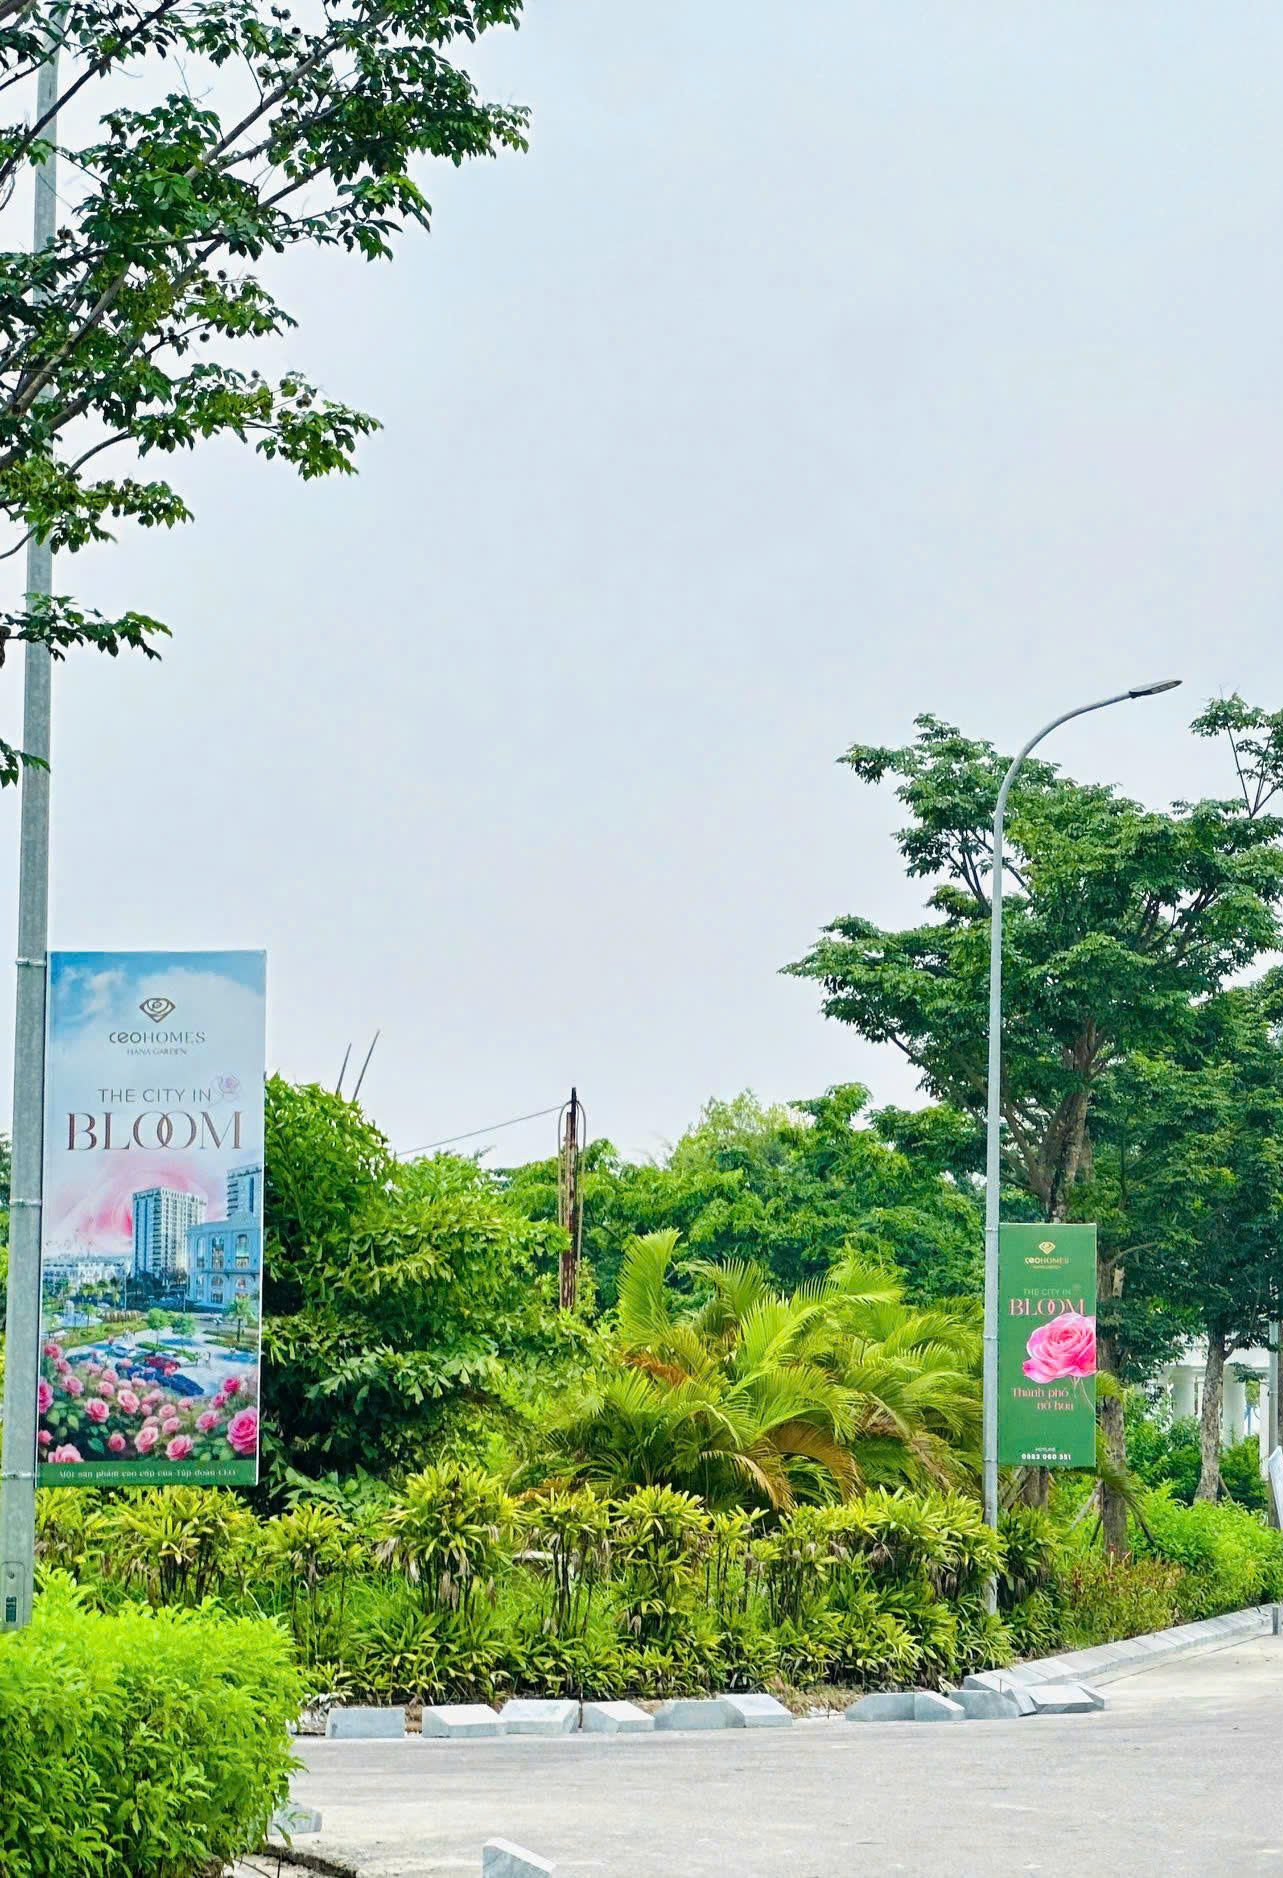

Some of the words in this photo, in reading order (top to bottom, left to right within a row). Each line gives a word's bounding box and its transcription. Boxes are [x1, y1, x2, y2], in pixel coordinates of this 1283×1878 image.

[127, 1048, 152, 1056] HANA
[153, 1048, 188, 1056] GARDEN
[97, 1088, 137, 1103] THE
[142, 1088, 186, 1103] CITY
[193, 1088, 212, 1103] IN
[66, 1110, 243, 1151] BLOOM
[1023, 1288, 1040, 1296] THE
[1040, 1288, 1061, 1296] CITY
[1062, 1288, 1072, 1296] IN
[1008, 1298, 1086, 1317] BLOOM
